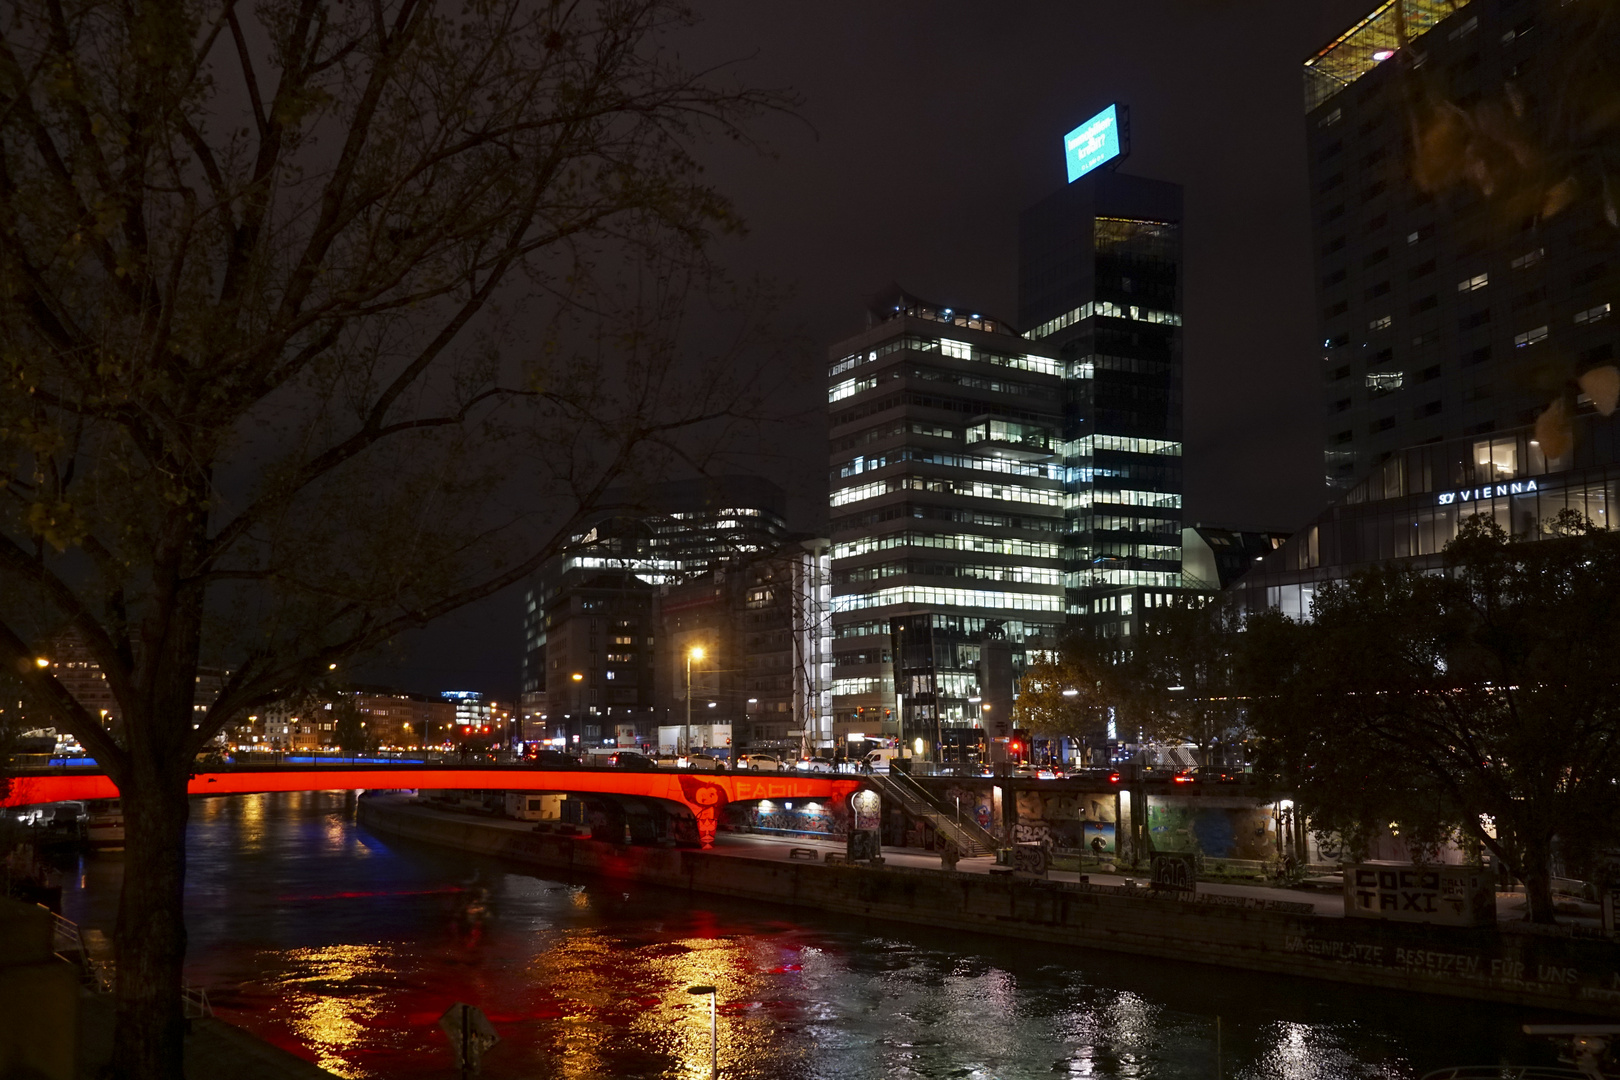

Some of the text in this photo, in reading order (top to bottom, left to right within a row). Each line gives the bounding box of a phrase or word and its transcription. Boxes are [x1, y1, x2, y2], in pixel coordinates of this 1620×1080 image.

[1460, 480, 1538, 501] VIENNA
[1356, 869, 1440, 890] COCO
[1356, 890, 1438, 914] TAXI
[1284, 935, 1384, 962] WAGENPLÄTZE
[1396, 946, 1479, 972] BESETZEN
[1491, 957, 1526, 978] FÜR
[1538, 964, 1578, 984] UNS
